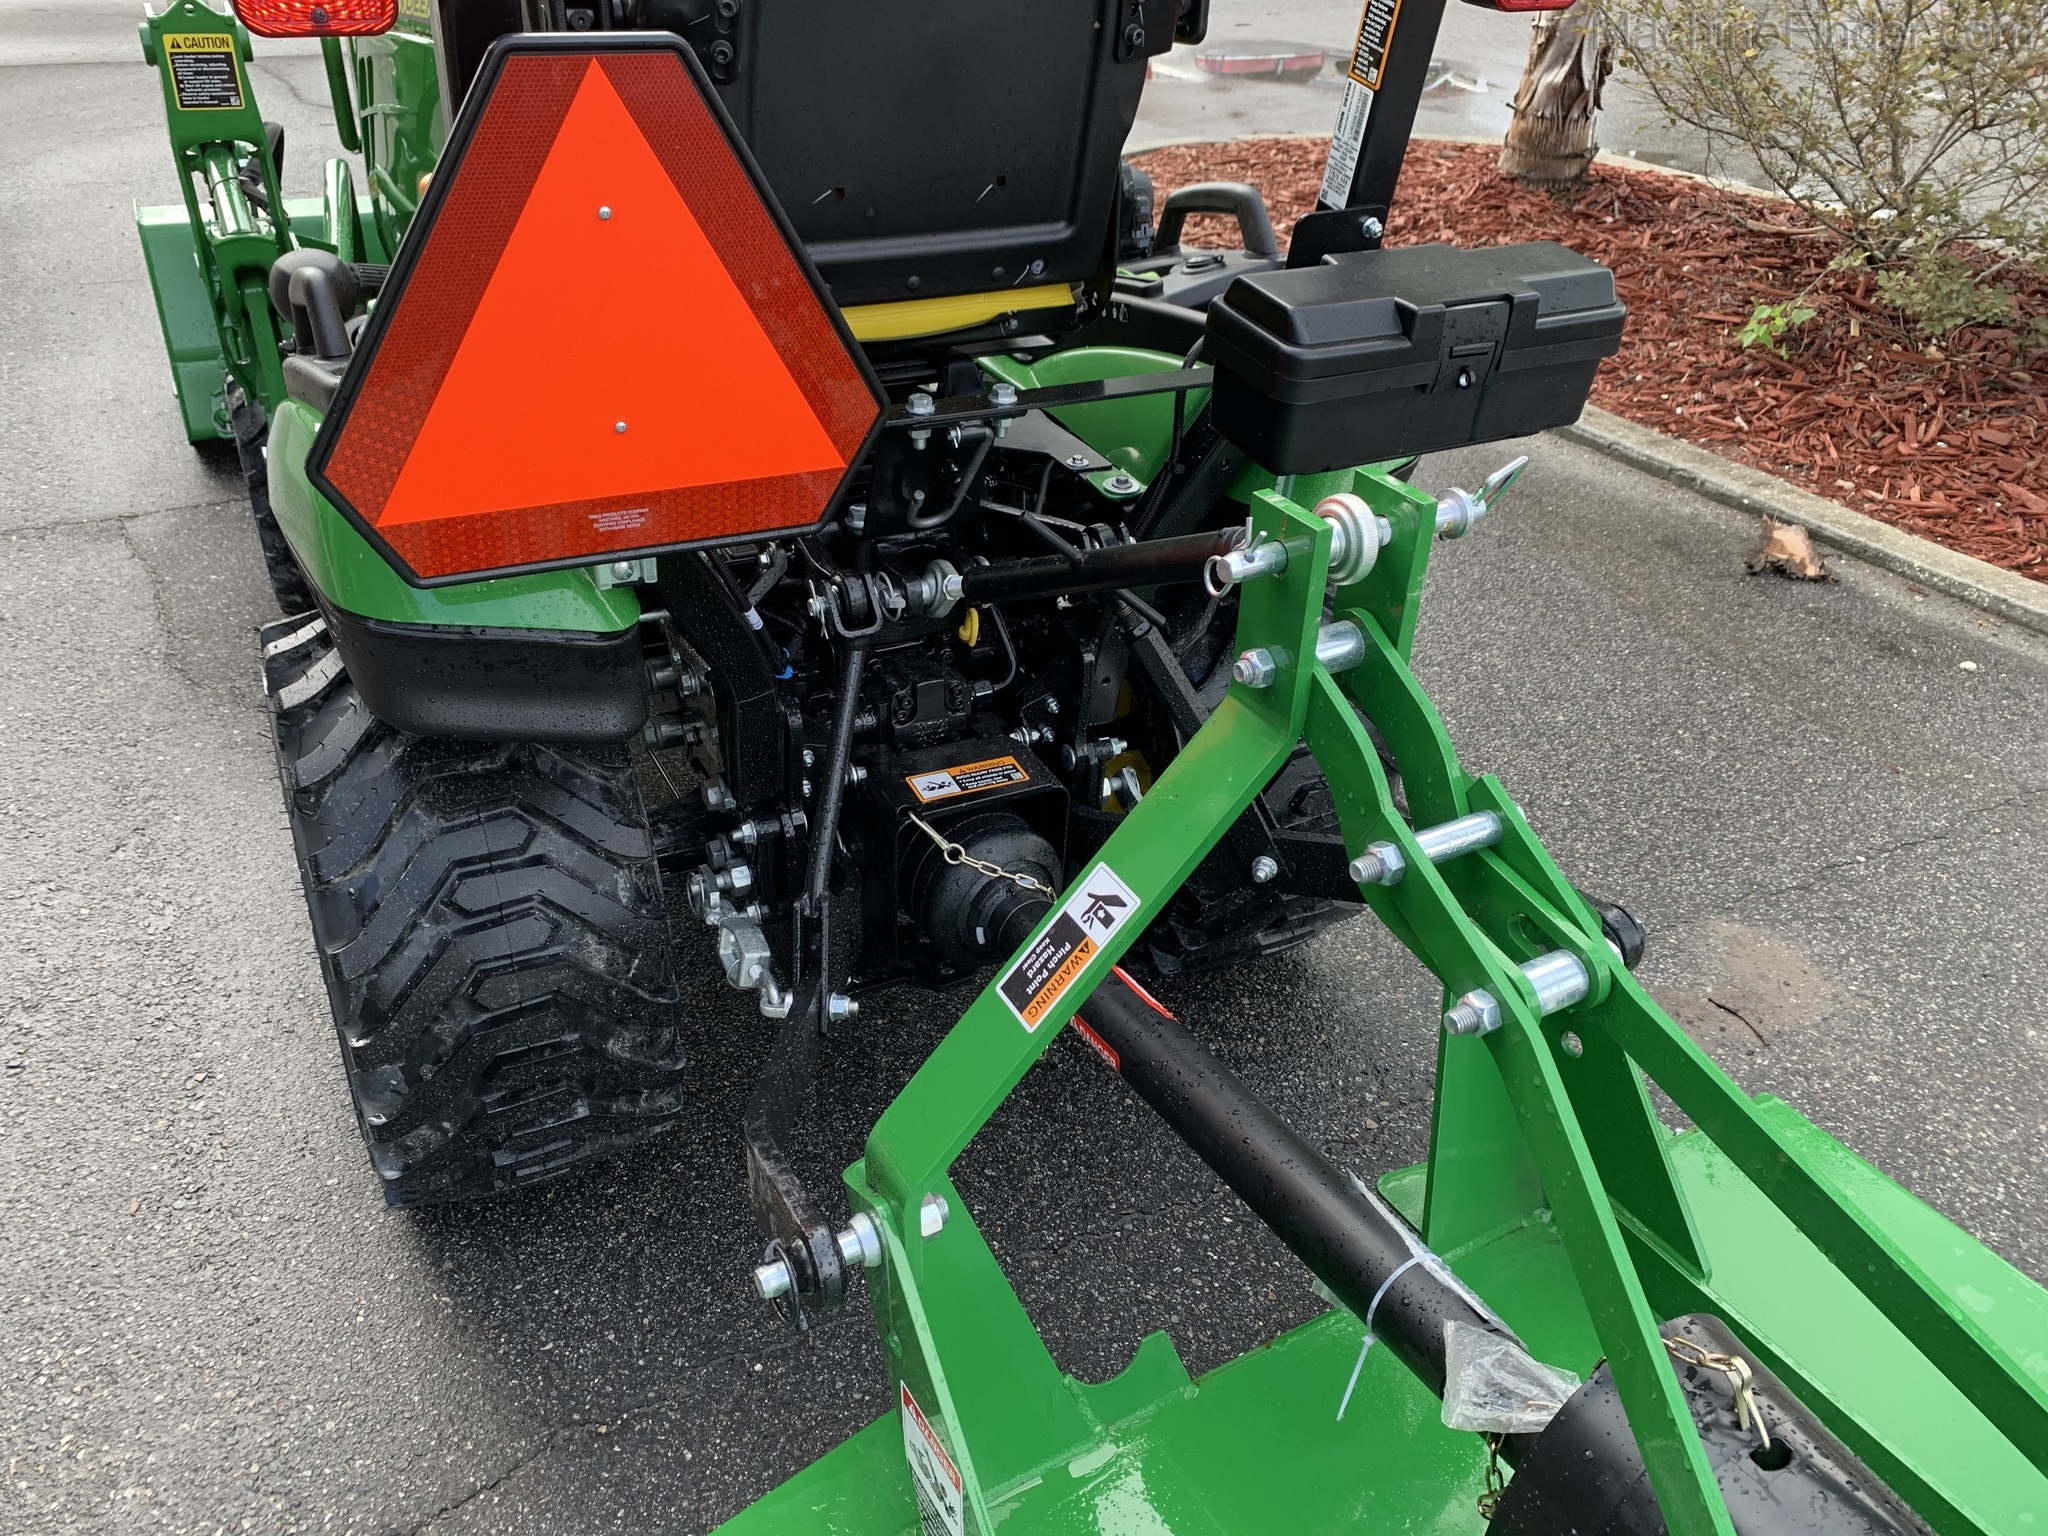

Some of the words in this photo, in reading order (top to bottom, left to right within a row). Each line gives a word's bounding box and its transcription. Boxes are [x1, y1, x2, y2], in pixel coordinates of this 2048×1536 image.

[183, 37, 230, 49] CAUTION
[1336, 111, 1345, 134] JOHN
[1343, 81, 1352, 107] DEERE
[966, 760, 1005, 772] WARNING
[1035, 937, 1051, 955] Keep
[1047, 941, 1071, 968] Pinch
[1022, 952, 1037, 971] Clear
[1027, 945, 1055, 979] Hazard
[1025, 967, 1049, 995] Point
[1028, 955, 1083, 1018] WARNING
[917, 1417, 956, 1484] DANGER
